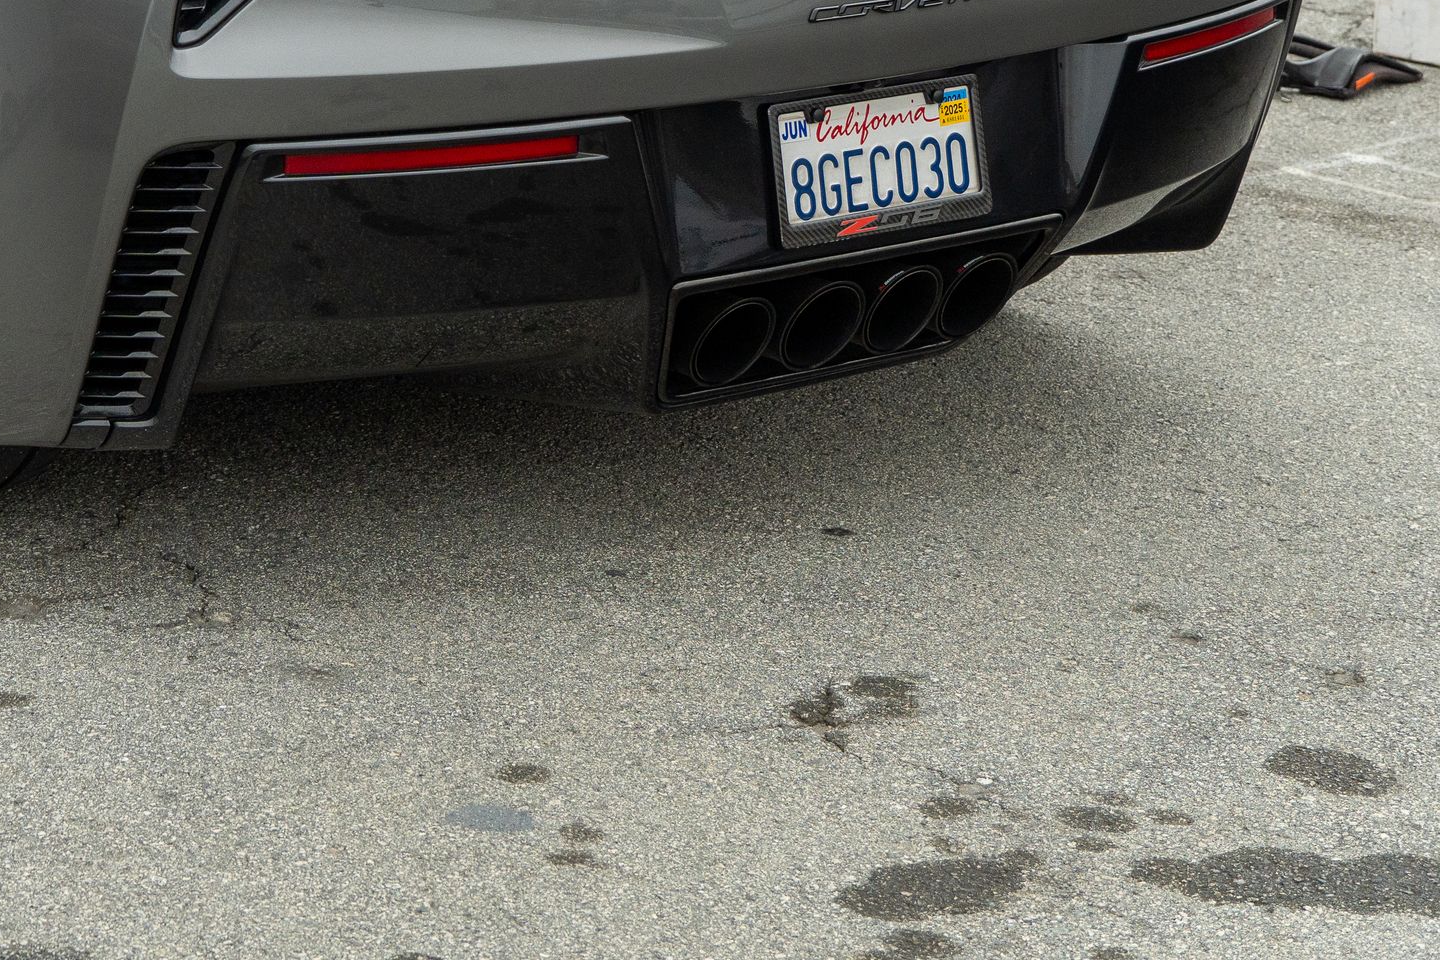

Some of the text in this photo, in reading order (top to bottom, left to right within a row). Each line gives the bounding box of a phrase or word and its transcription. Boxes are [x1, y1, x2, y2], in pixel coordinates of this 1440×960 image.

[816, 100, 939, 145] California
[944, 102, 963, 116] 2025
[782, 119, 807, 140] JUN
[791, 132, 969, 221] 8GEC030
[836, 206, 942, 237] Z06
